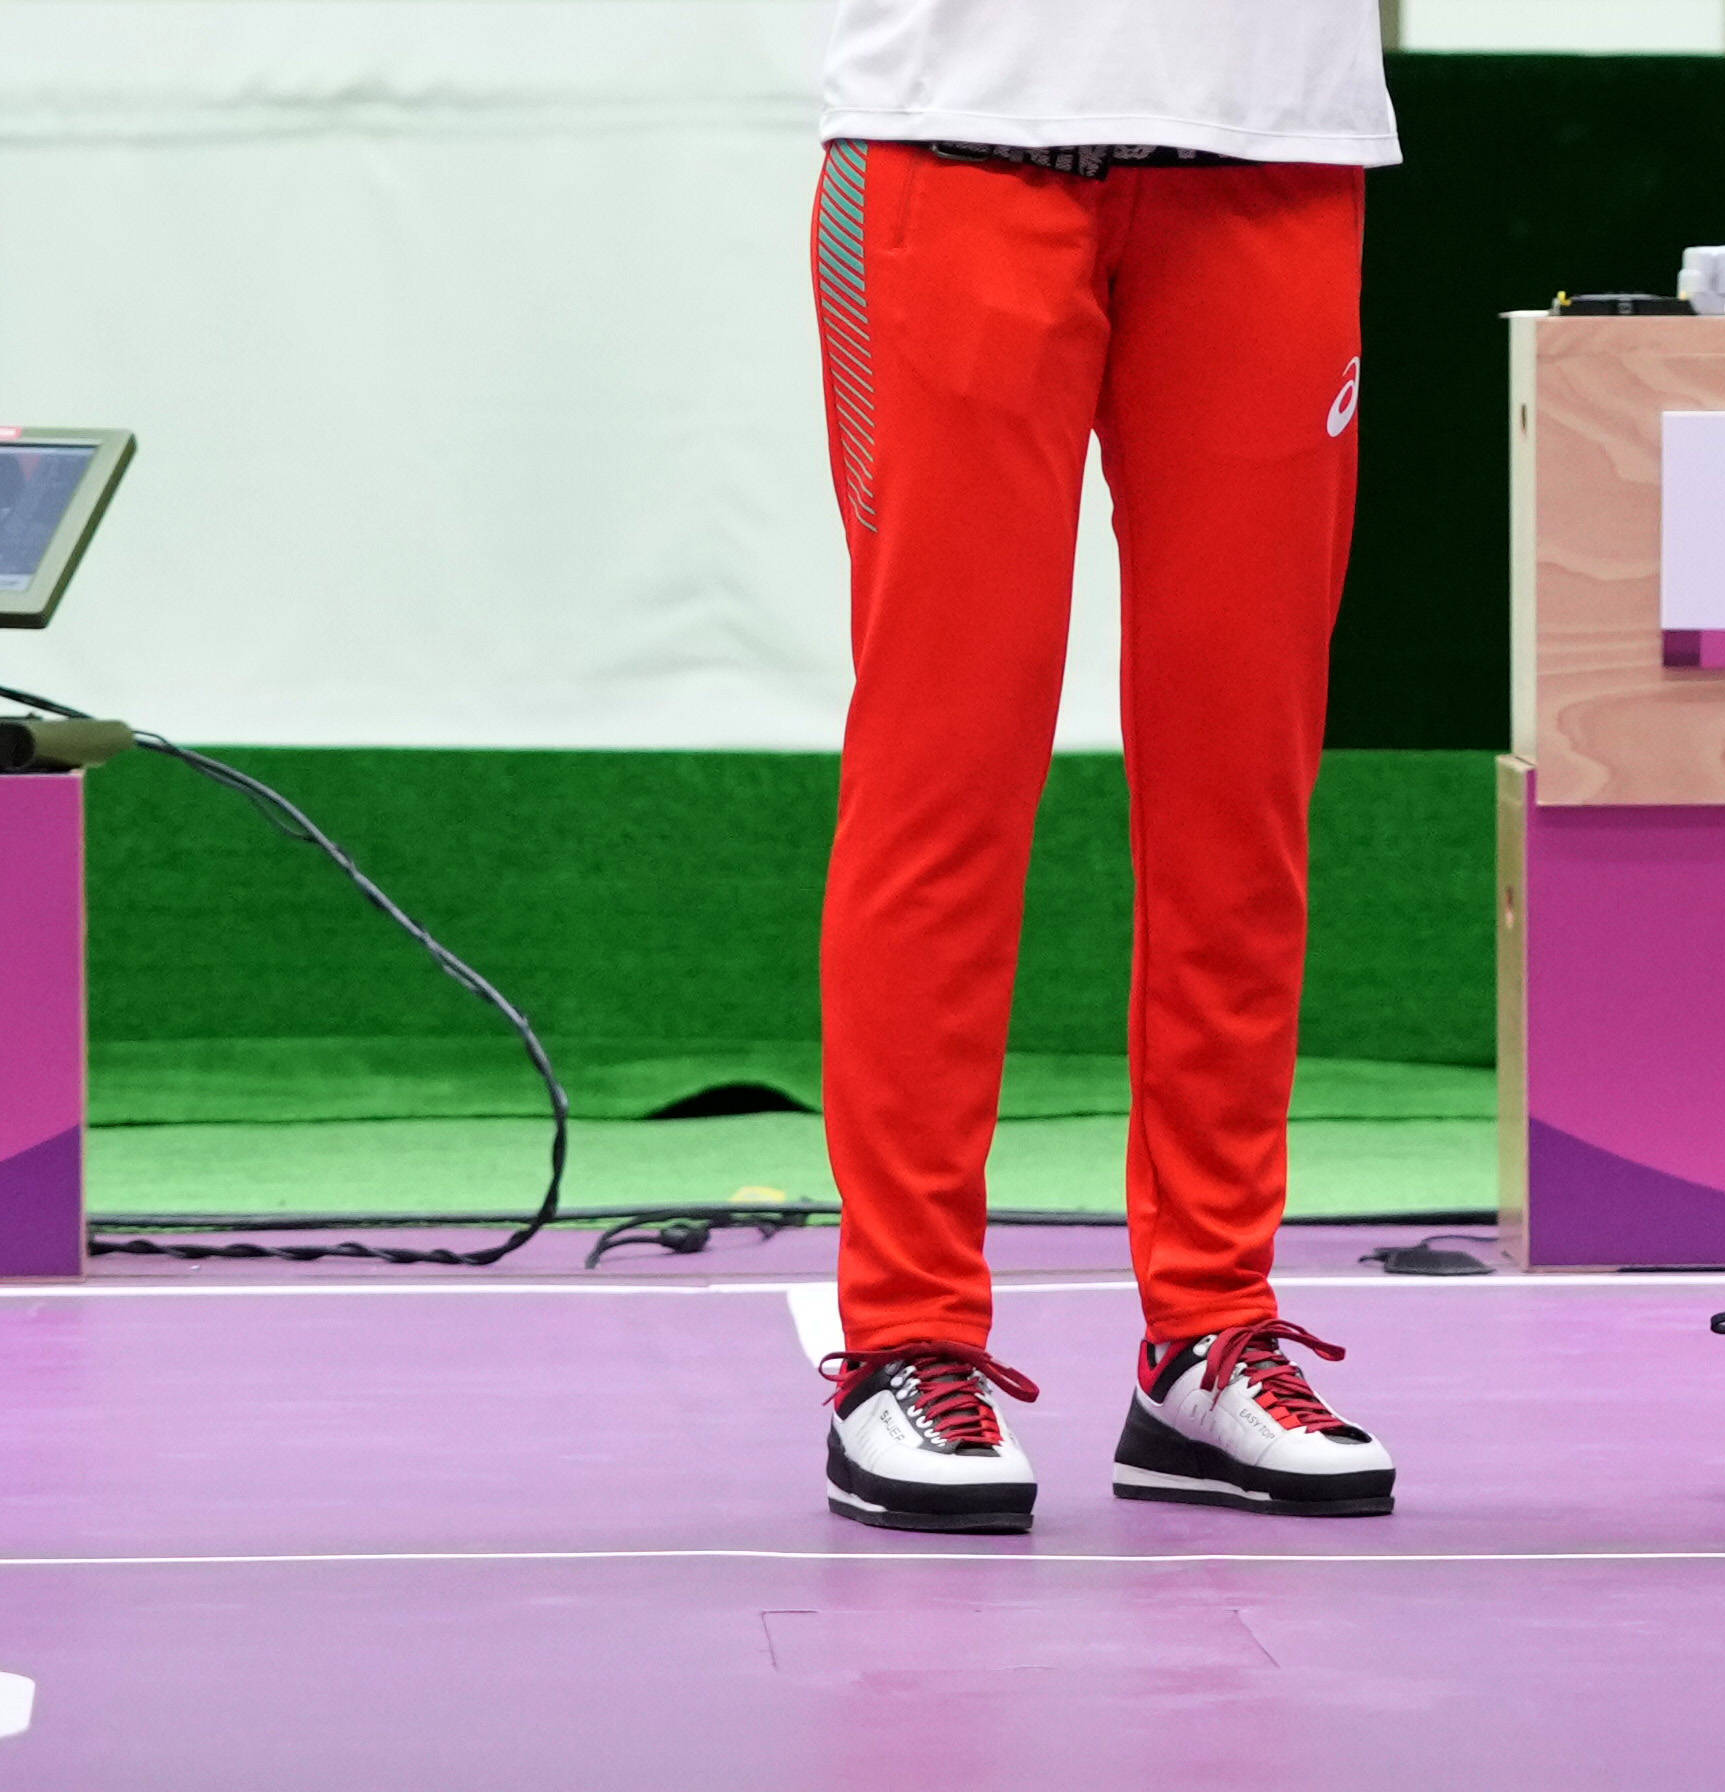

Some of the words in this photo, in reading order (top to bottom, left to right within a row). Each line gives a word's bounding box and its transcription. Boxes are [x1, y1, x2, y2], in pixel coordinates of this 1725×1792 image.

[880, 1409, 905, 1441] SAUER
[1239, 1408, 1261, 1427] EASY
[1260, 1426, 1276, 1439] TOP
